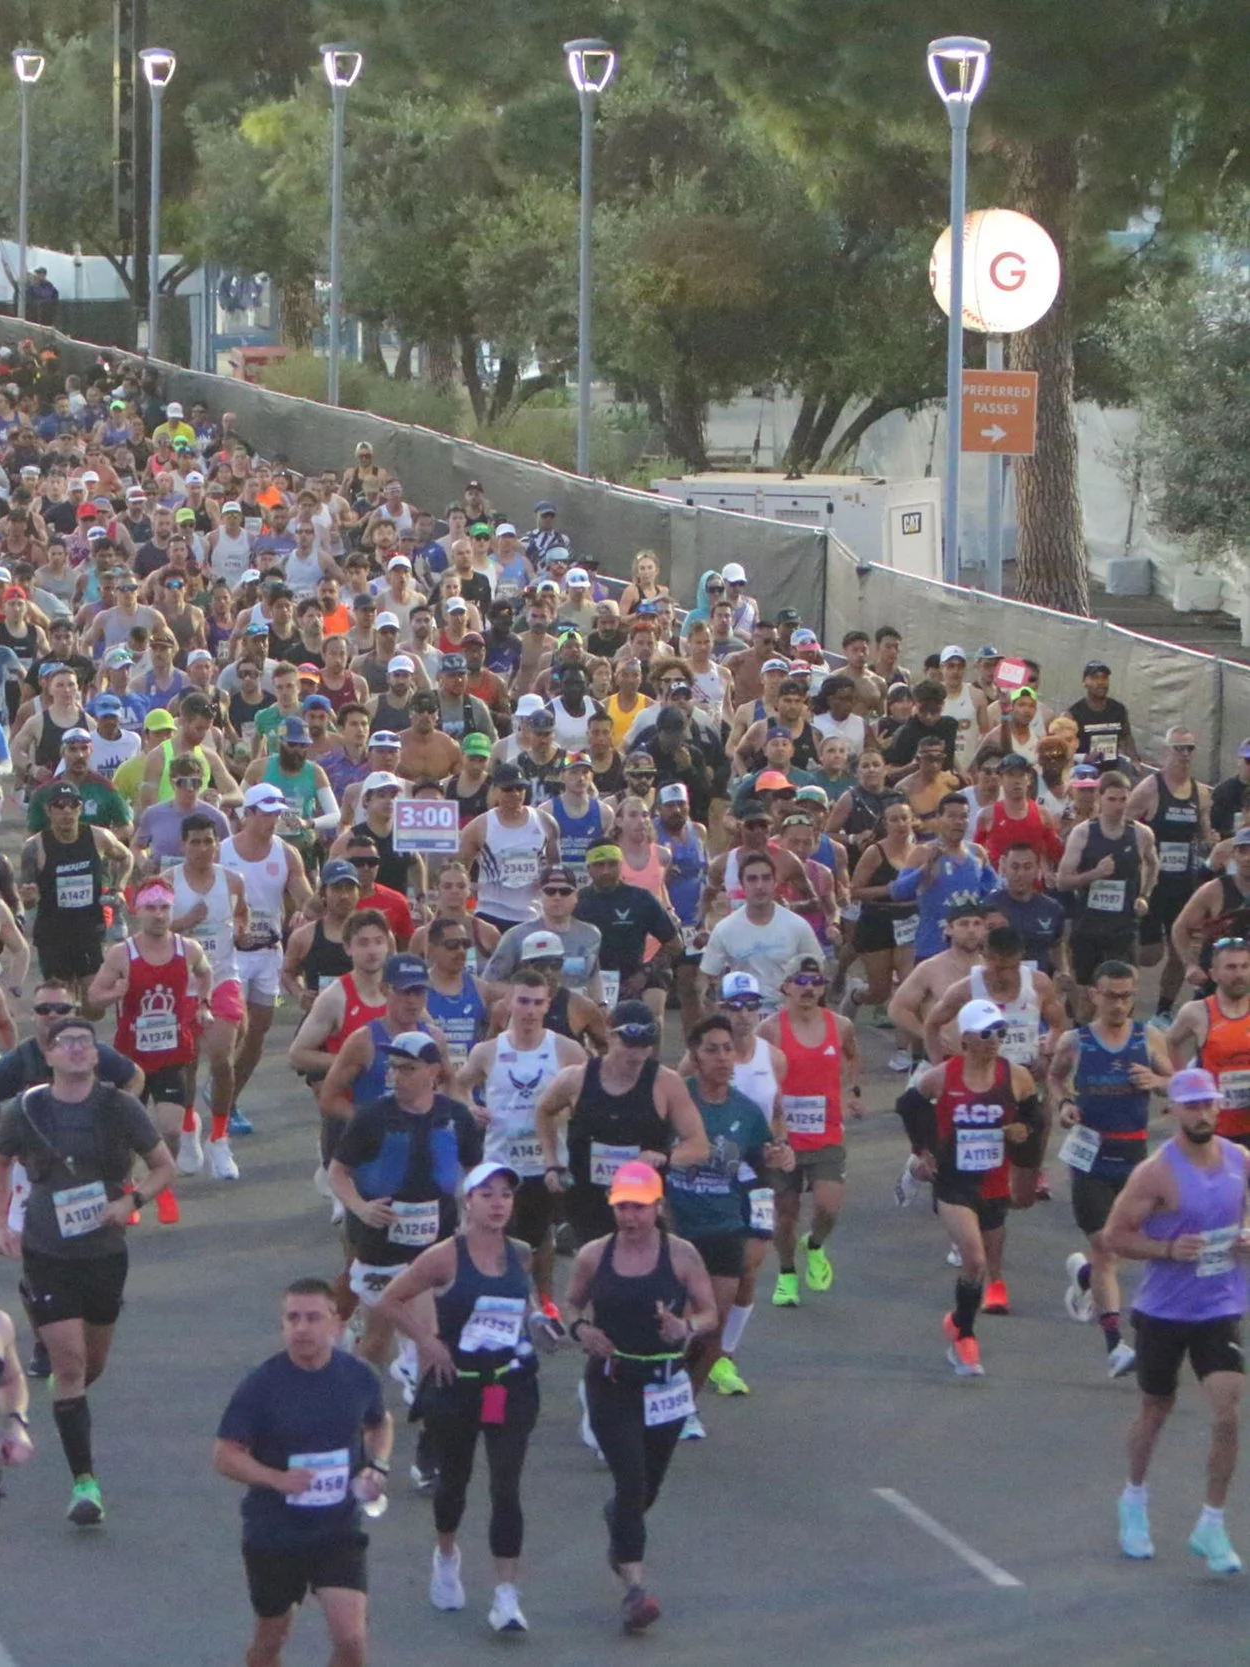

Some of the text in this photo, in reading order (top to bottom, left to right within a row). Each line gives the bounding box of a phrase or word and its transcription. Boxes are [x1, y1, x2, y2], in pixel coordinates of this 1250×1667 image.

[989, 251, 1027, 292] G
[963, 384, 1031, 398] PREFERRED
[973, 403, 1018, 416] PASSES
[401, 806, 453, 828] 3:00
[59, 889, 90, 901] A1427
[139, 1030, 174, 1043] A1376
[953, 1104, 1005, 1123] ACP
